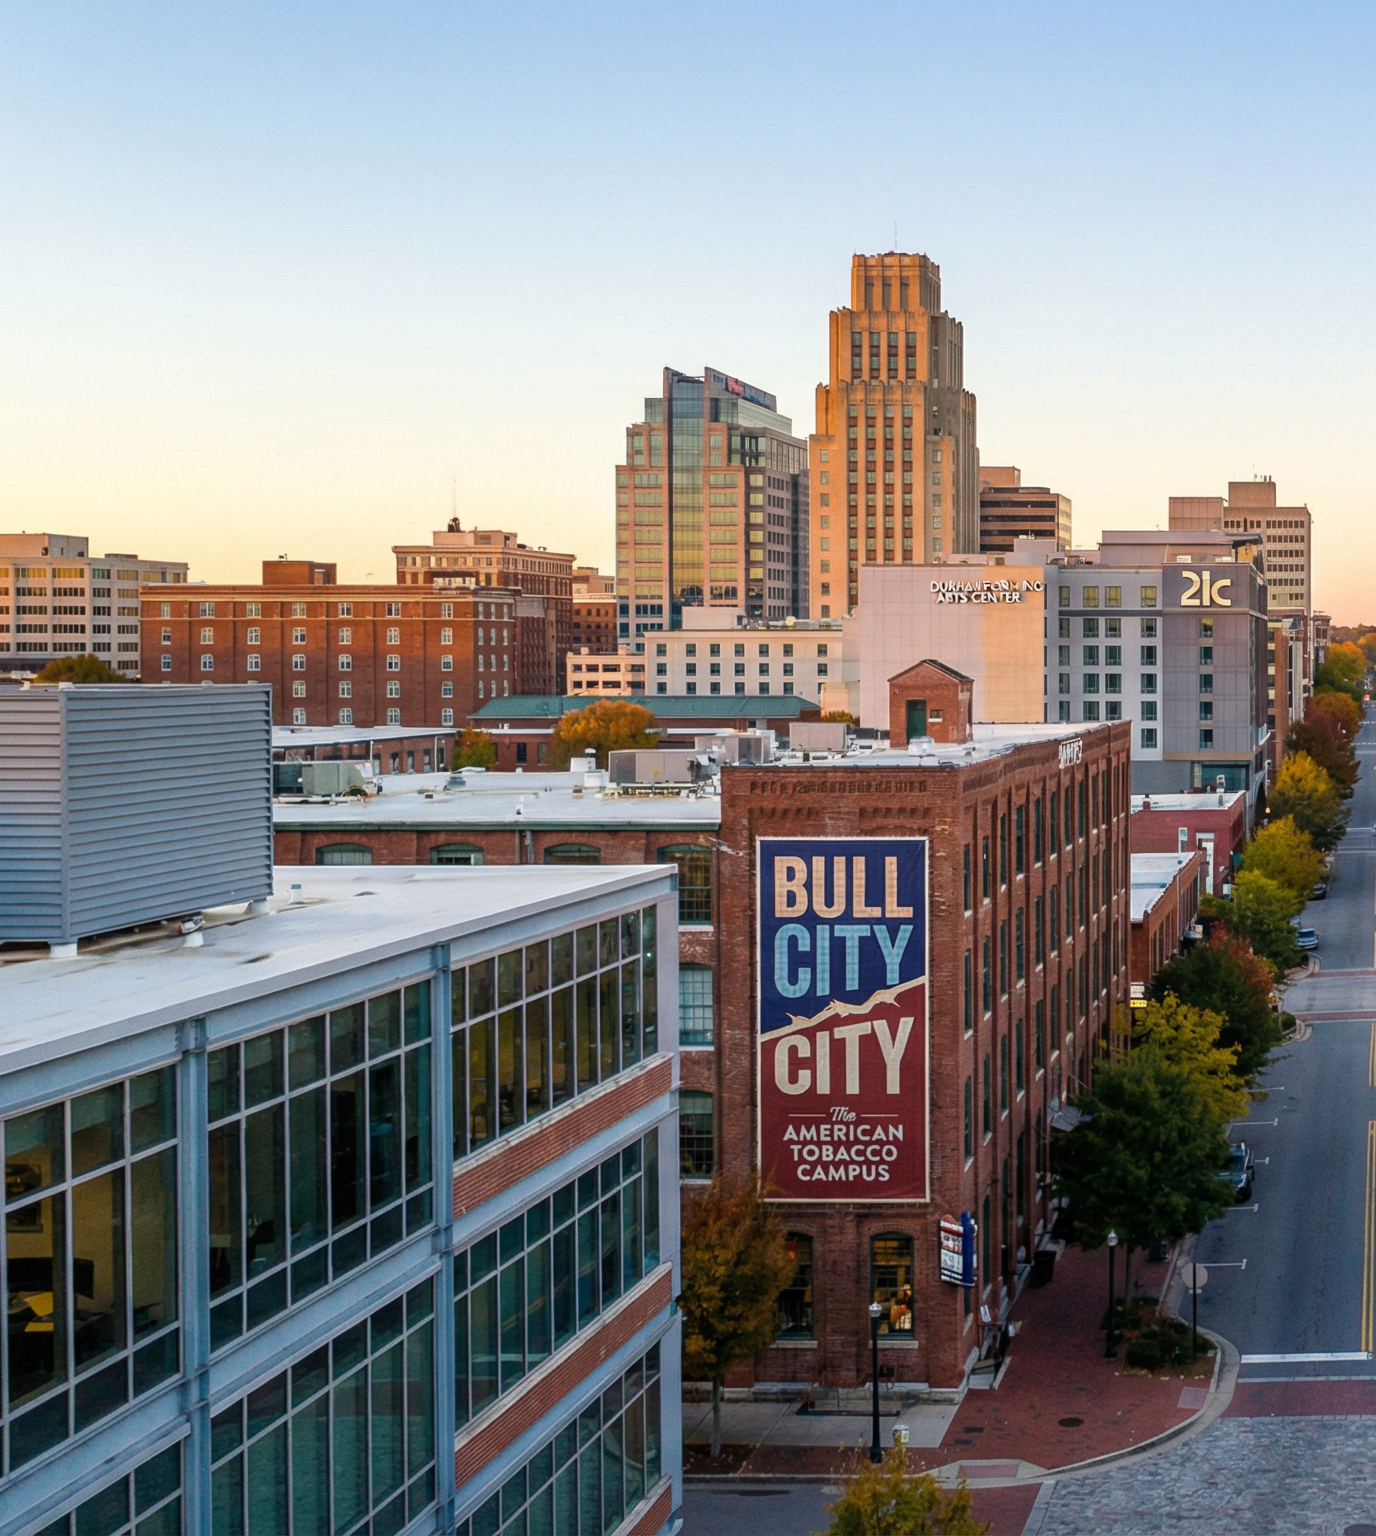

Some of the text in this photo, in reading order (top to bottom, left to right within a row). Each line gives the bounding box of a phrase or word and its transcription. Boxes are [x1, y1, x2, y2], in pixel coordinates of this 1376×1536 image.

[774, 856, 914, 919] BULL
[774, 923, 914, 999] CITY
[774, 1016, 915, 1095] CITY
[830, 1106, 857, 1122] The
[783, 1124, 904, 1141] AMERICAN
[790, 1144, 898, 1161] TOBACCO
[797, 1164, 890, 1181] CAMPUS
